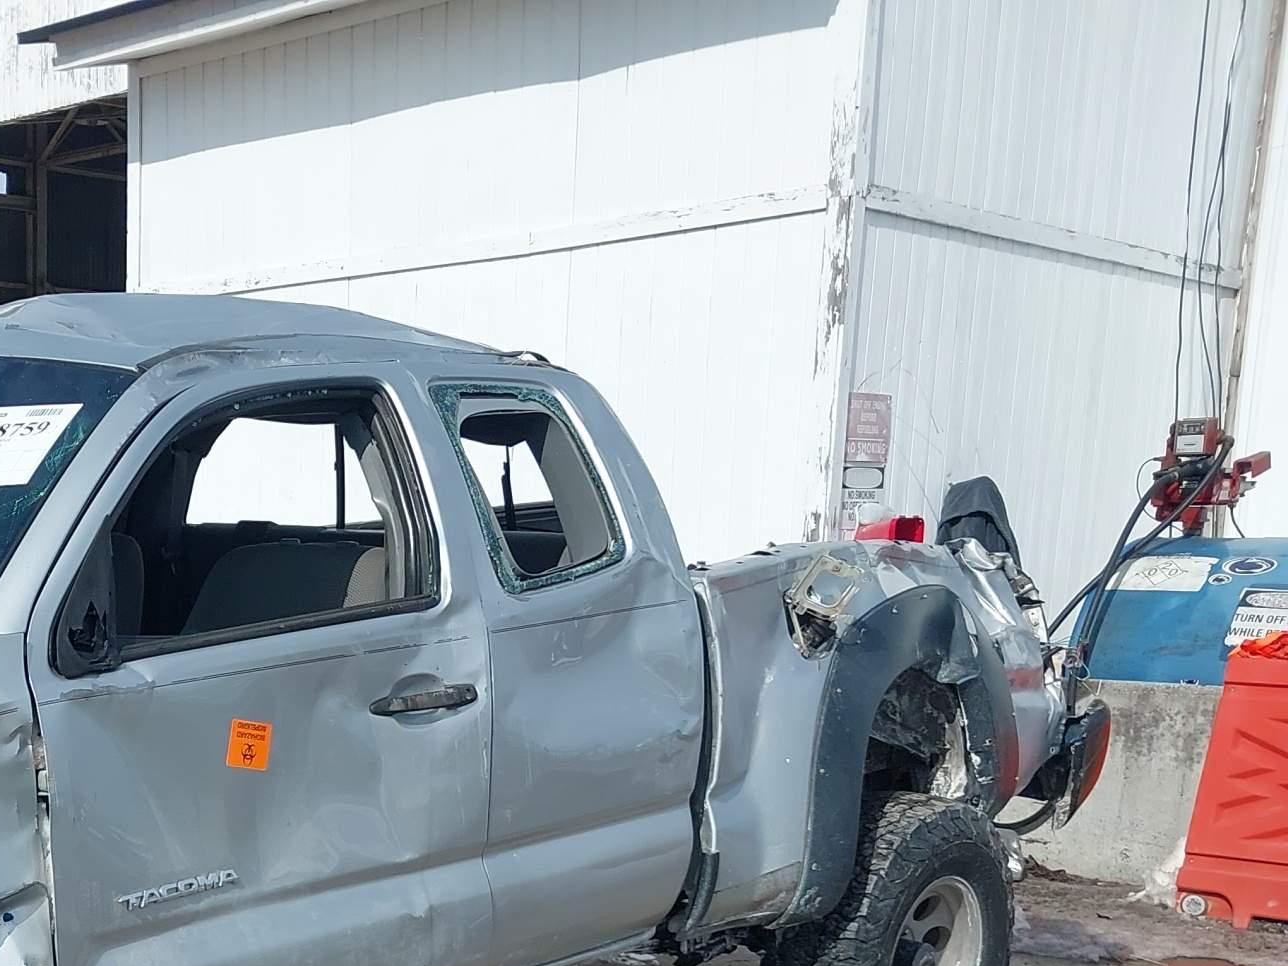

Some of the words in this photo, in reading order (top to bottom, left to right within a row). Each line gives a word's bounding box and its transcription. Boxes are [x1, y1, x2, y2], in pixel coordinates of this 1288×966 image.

[857, 441, 887, 455] SMOKING
[1234, 613, 1264, 623] TURN
[1266, 615, 1287, 624] OFF
[1228, 627, 1264, 637] WHILE
[118, 868, 240, 911] TACOMA
